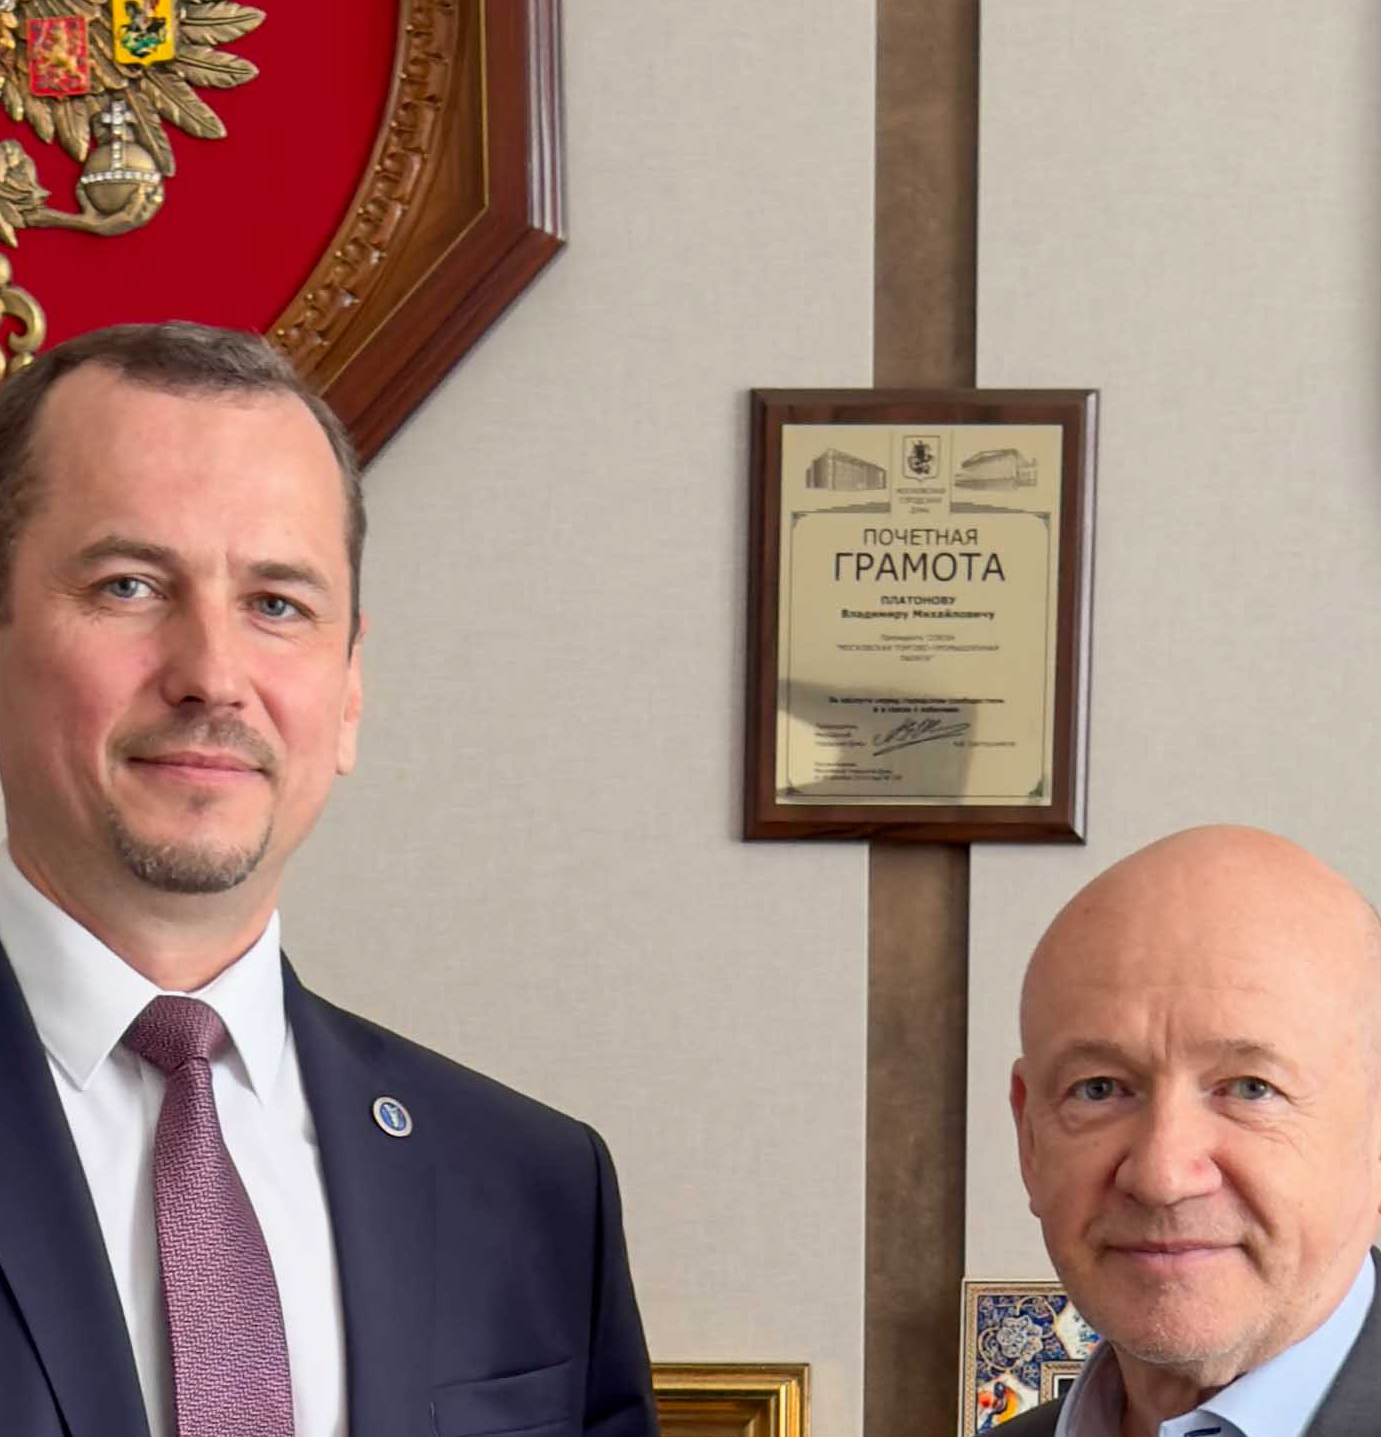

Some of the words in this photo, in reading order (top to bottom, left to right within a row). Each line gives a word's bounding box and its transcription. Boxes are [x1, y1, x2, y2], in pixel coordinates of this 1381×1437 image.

[863, 528, 978, 546] ПОЧЕТНАЯ
[834, 552, 1006, 582] ГРАМОТА
[880, 595, 956, 605] ПЛАТОНОВУ
